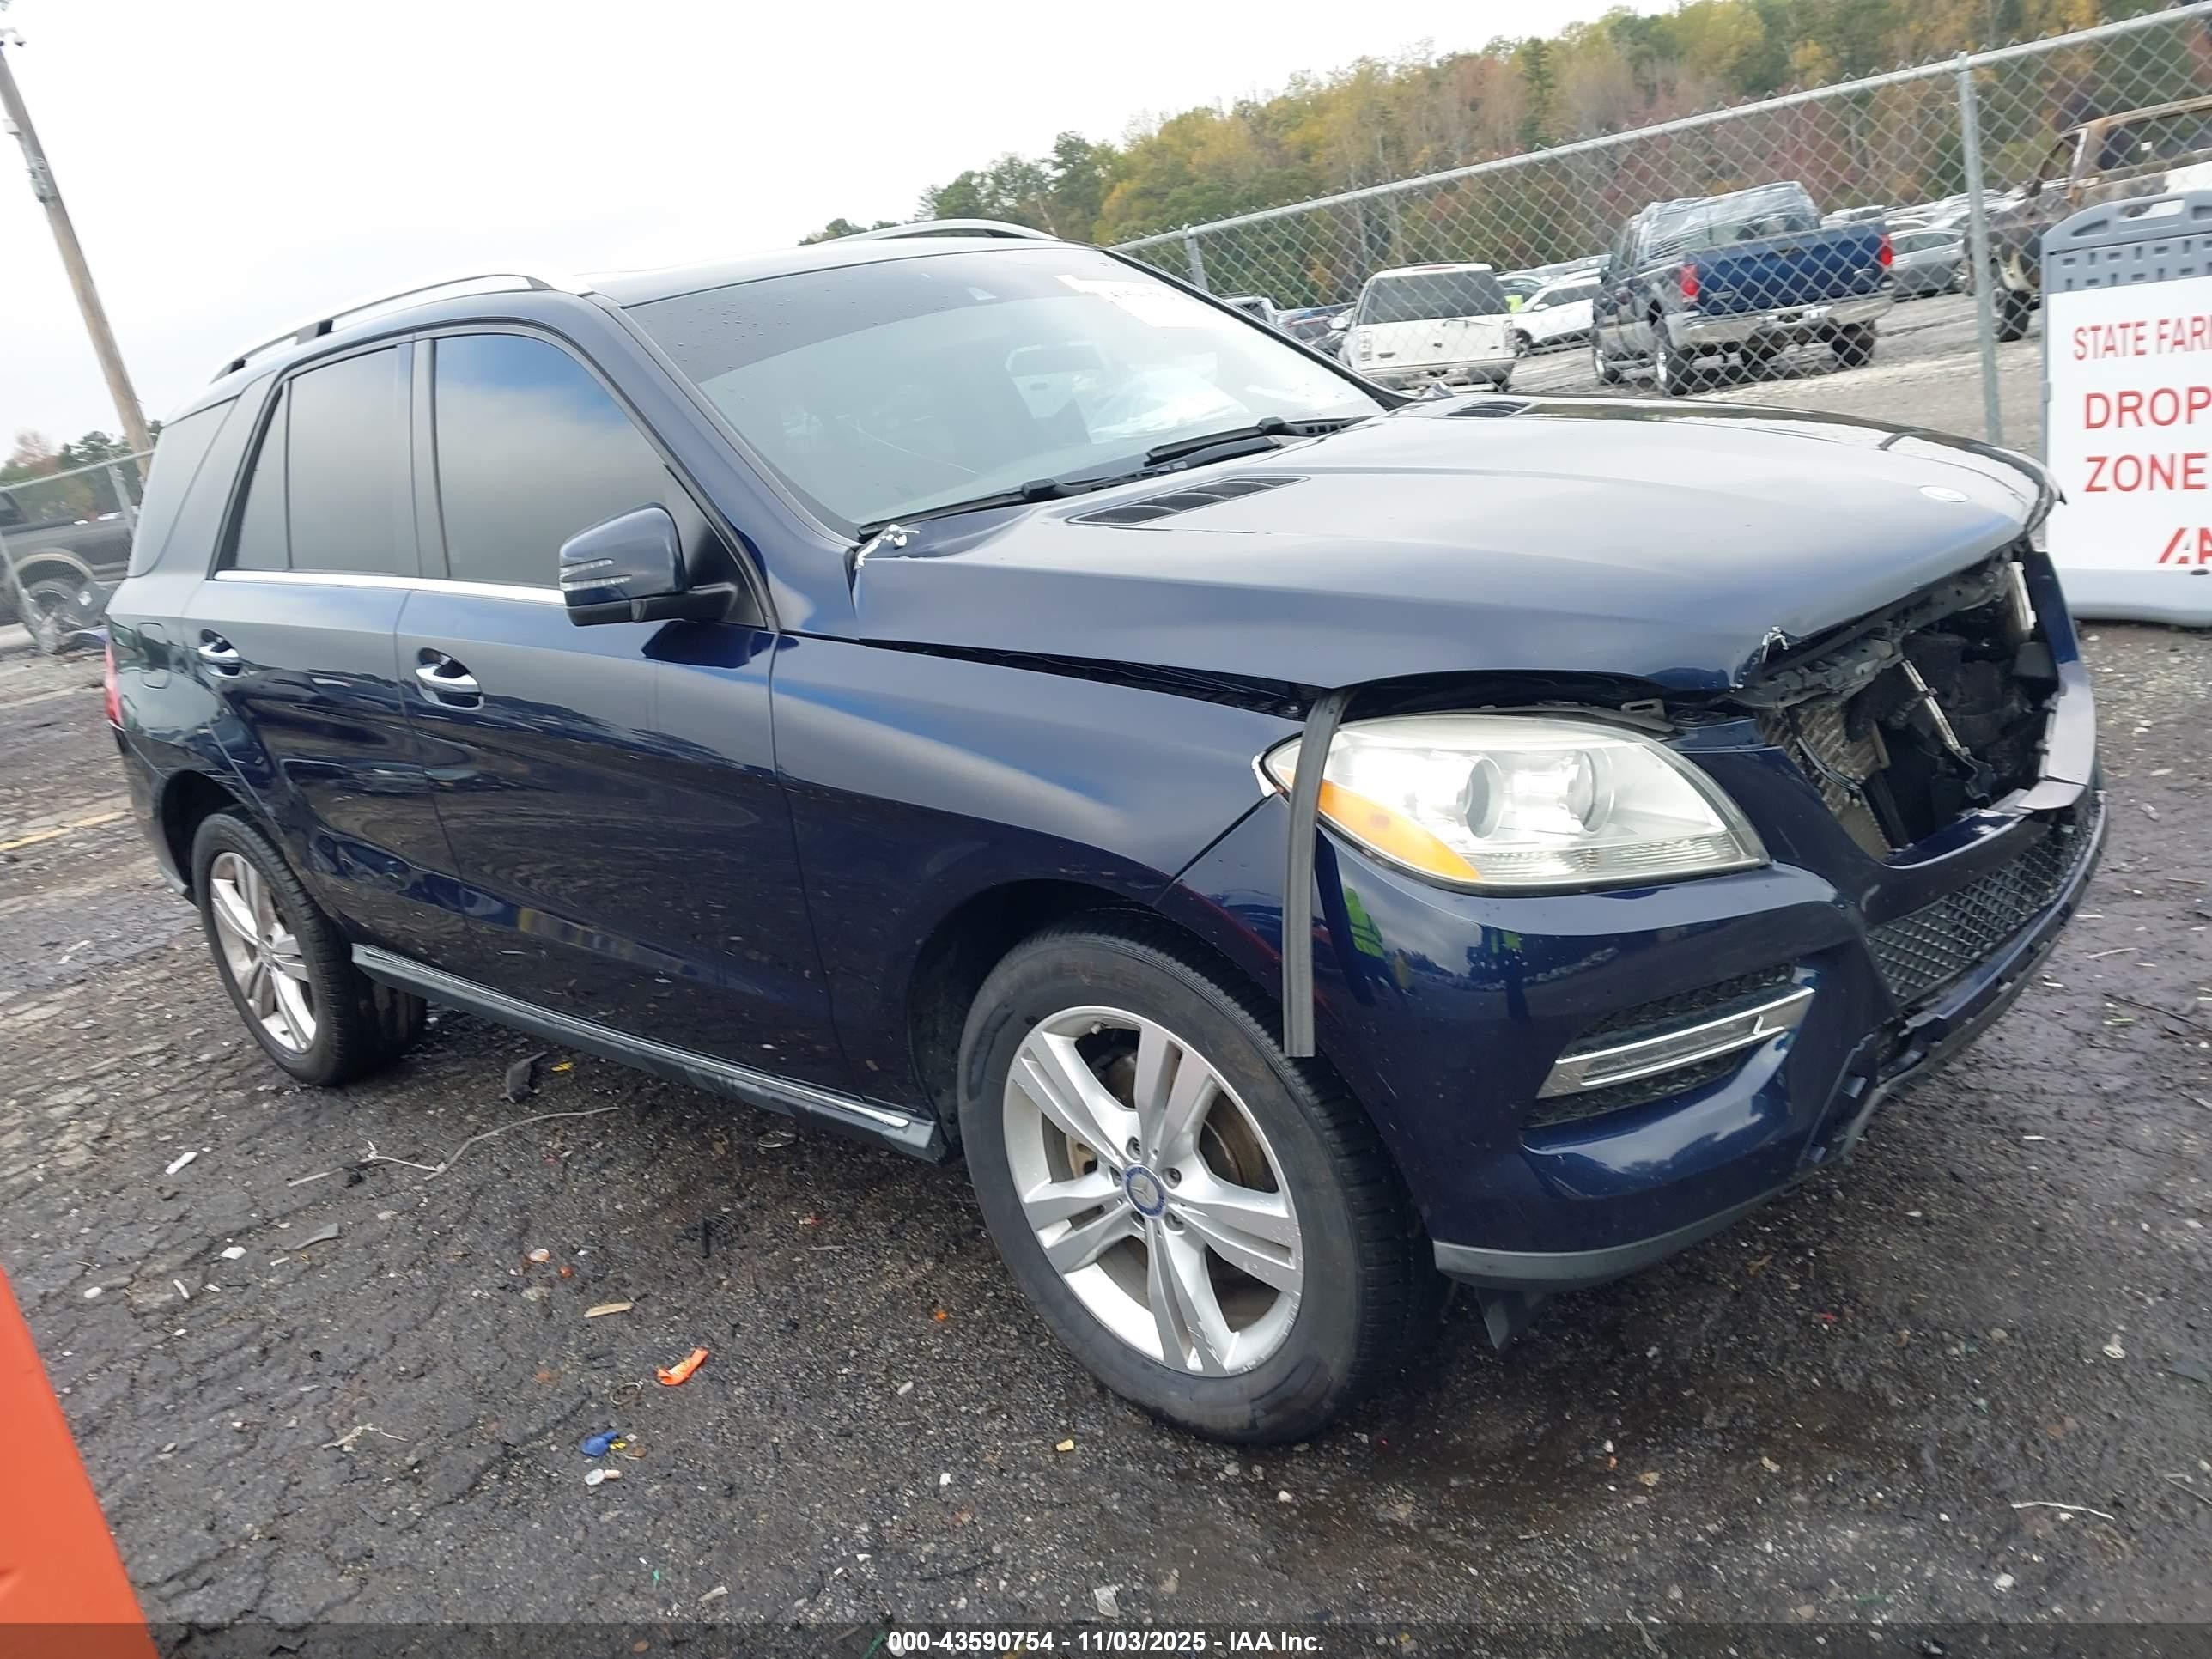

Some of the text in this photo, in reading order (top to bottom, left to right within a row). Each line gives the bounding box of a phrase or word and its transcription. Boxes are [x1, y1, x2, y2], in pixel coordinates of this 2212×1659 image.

[2074, 315, 2212, 360] STATE FAR
[2084, 386, 2212, 429] DROP
[2084, 452, 2209, 493] ZONE
